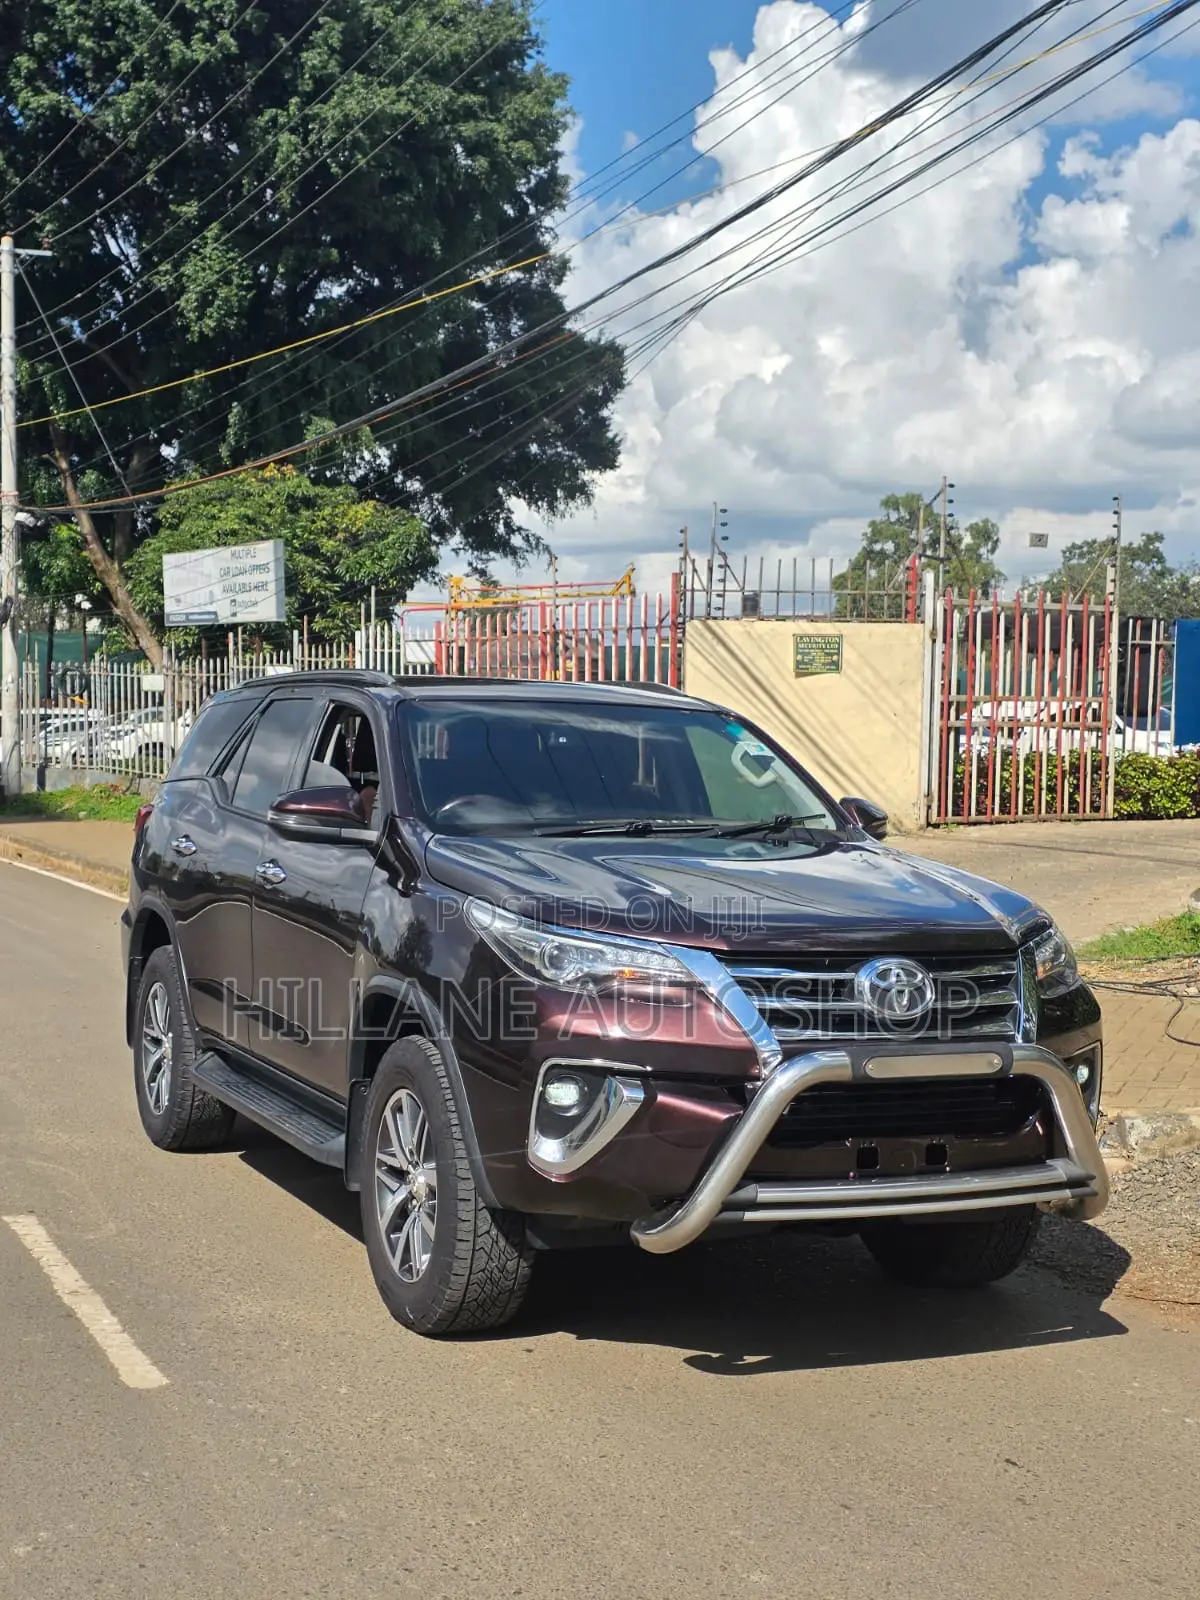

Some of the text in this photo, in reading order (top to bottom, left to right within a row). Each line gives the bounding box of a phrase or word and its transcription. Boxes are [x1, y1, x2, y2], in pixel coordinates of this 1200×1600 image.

[231, 548, 256, 560] MULTIPLE
[220, 563, 270, 578] CAR LOAN OFFERS
[223, 580, 269, 594] AVAILABLE HERE
